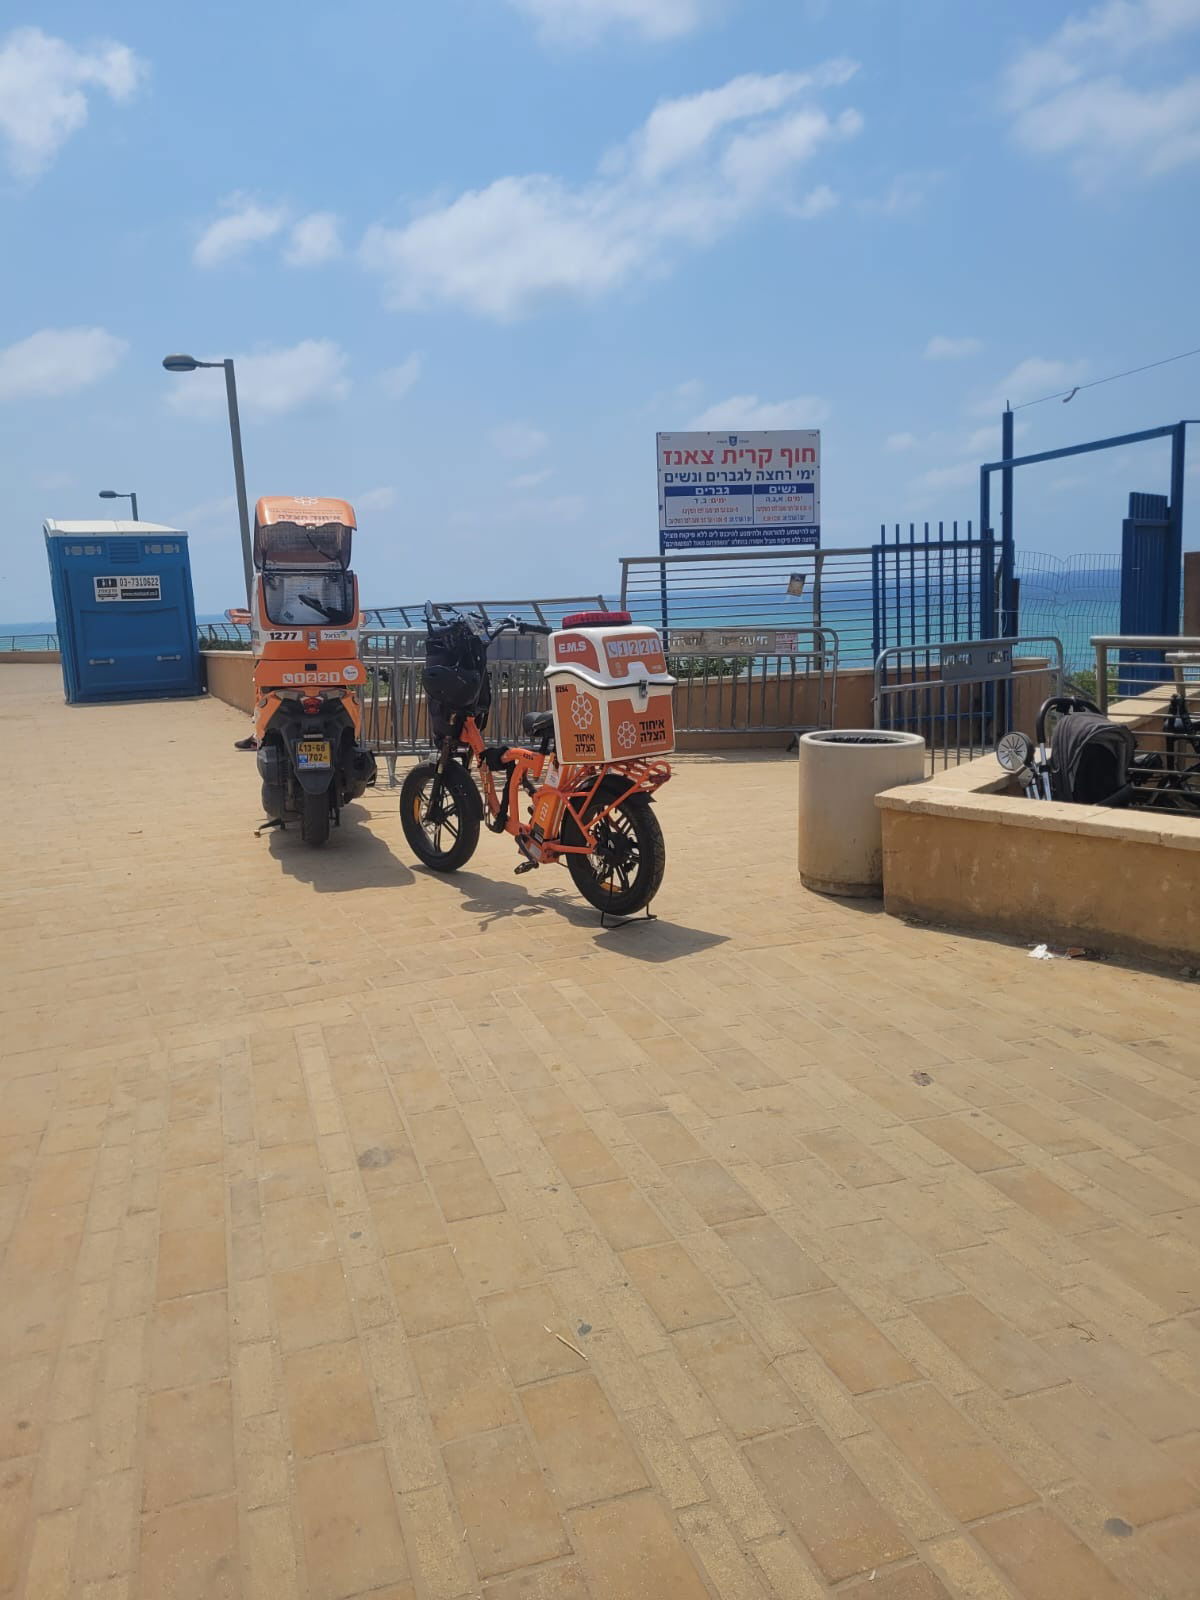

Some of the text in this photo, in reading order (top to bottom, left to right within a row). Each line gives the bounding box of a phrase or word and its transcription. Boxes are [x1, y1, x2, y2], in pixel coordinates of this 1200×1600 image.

[663, 447, 815, 469] חוף קרית צאנז
[664, 468, 815, 483] ימי רחצה לגברים ונשים
[695, 486, 729, 495] גברים
[769, 485, 796, 494] נשים
[269, 631, 297, 640] 1277
[620, 639, 658, 657] 1221
[295, 672, 338, 682] 1221
[639, 719, 665, 731] איחוד
[574, 733, 595, 742] איחוד
[640, 730, 666, 742] הצלה
[575, 743, 596, 752] הצלה
